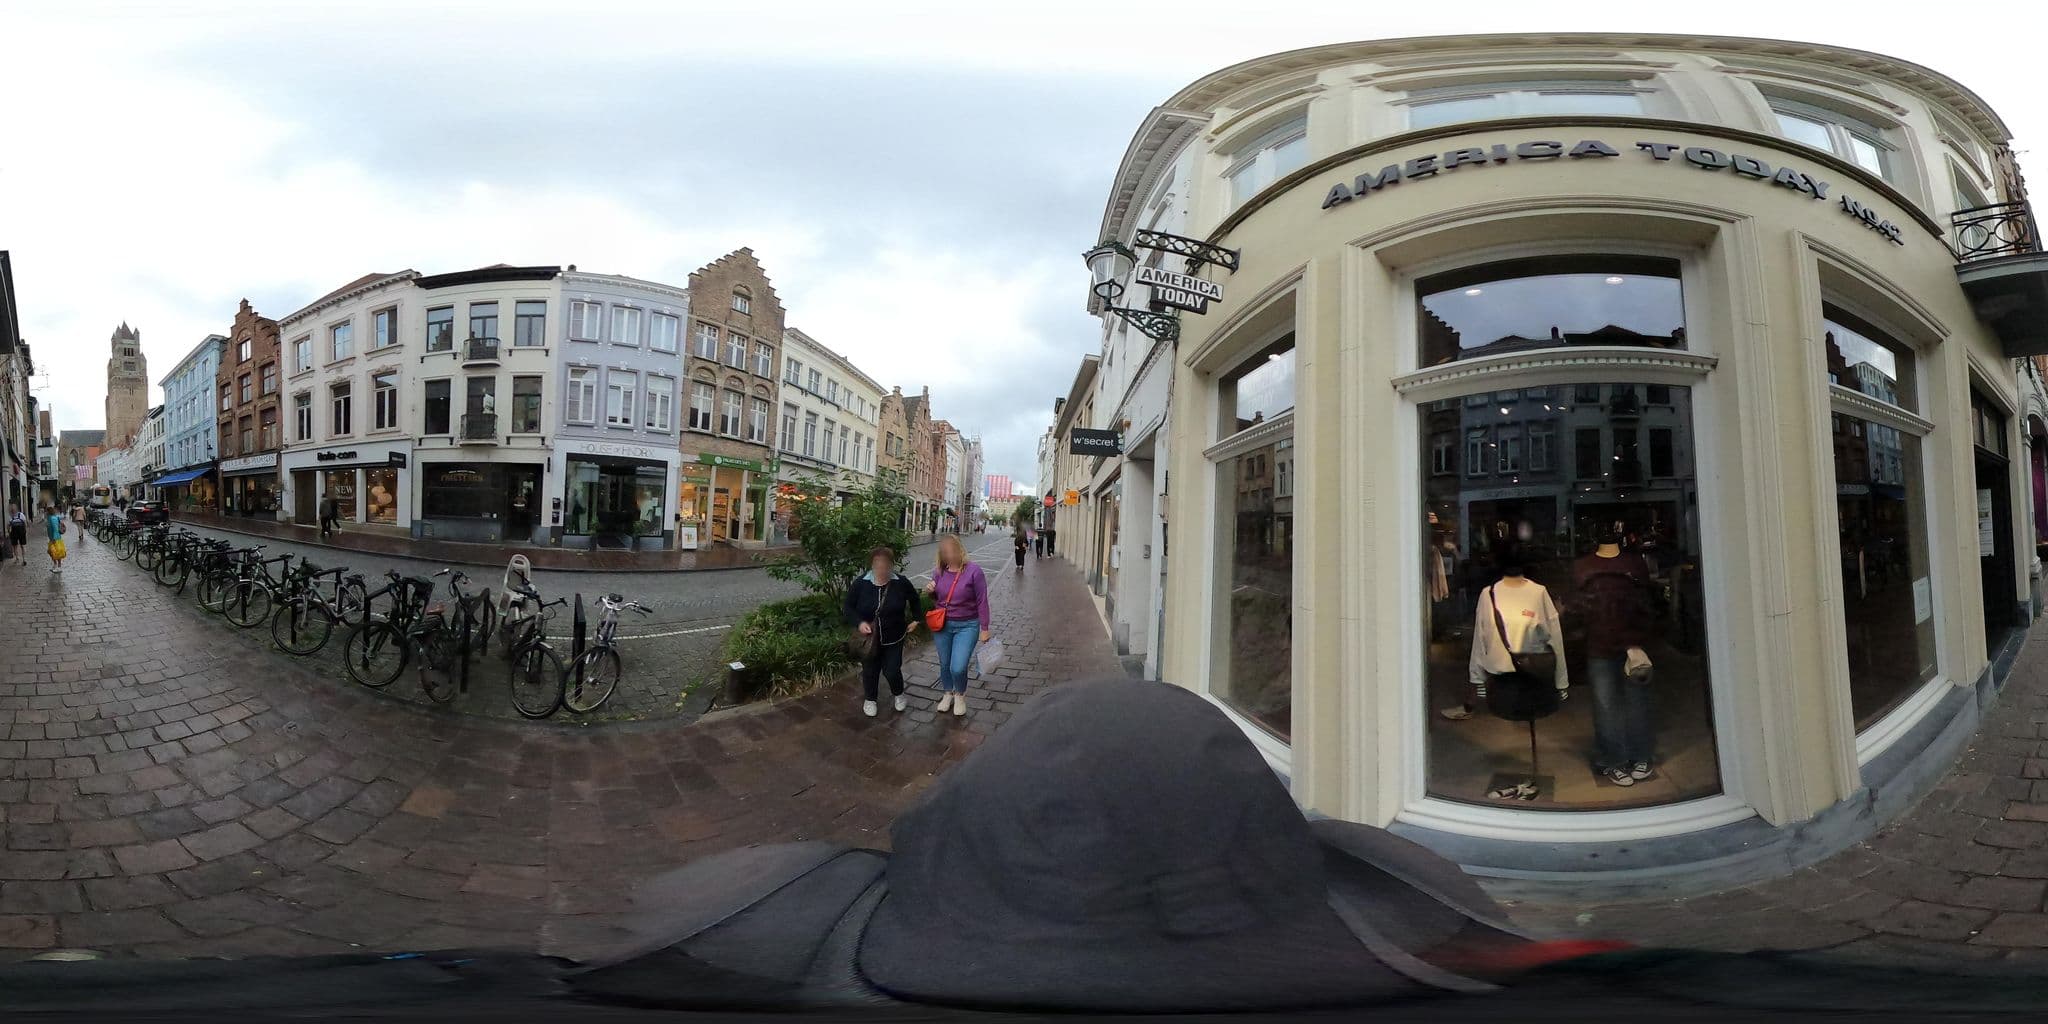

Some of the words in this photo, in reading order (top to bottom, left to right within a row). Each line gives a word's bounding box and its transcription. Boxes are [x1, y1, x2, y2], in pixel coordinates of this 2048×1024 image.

[1321, 139, 1620, 210] AMERICA
[1635, 141, 1831, 200] TODAY
[1140, 269, 1220, 297] AMERICA
[1157, 286, 1205, 309] TODAY
[335, 485, 353, 495] NEW
